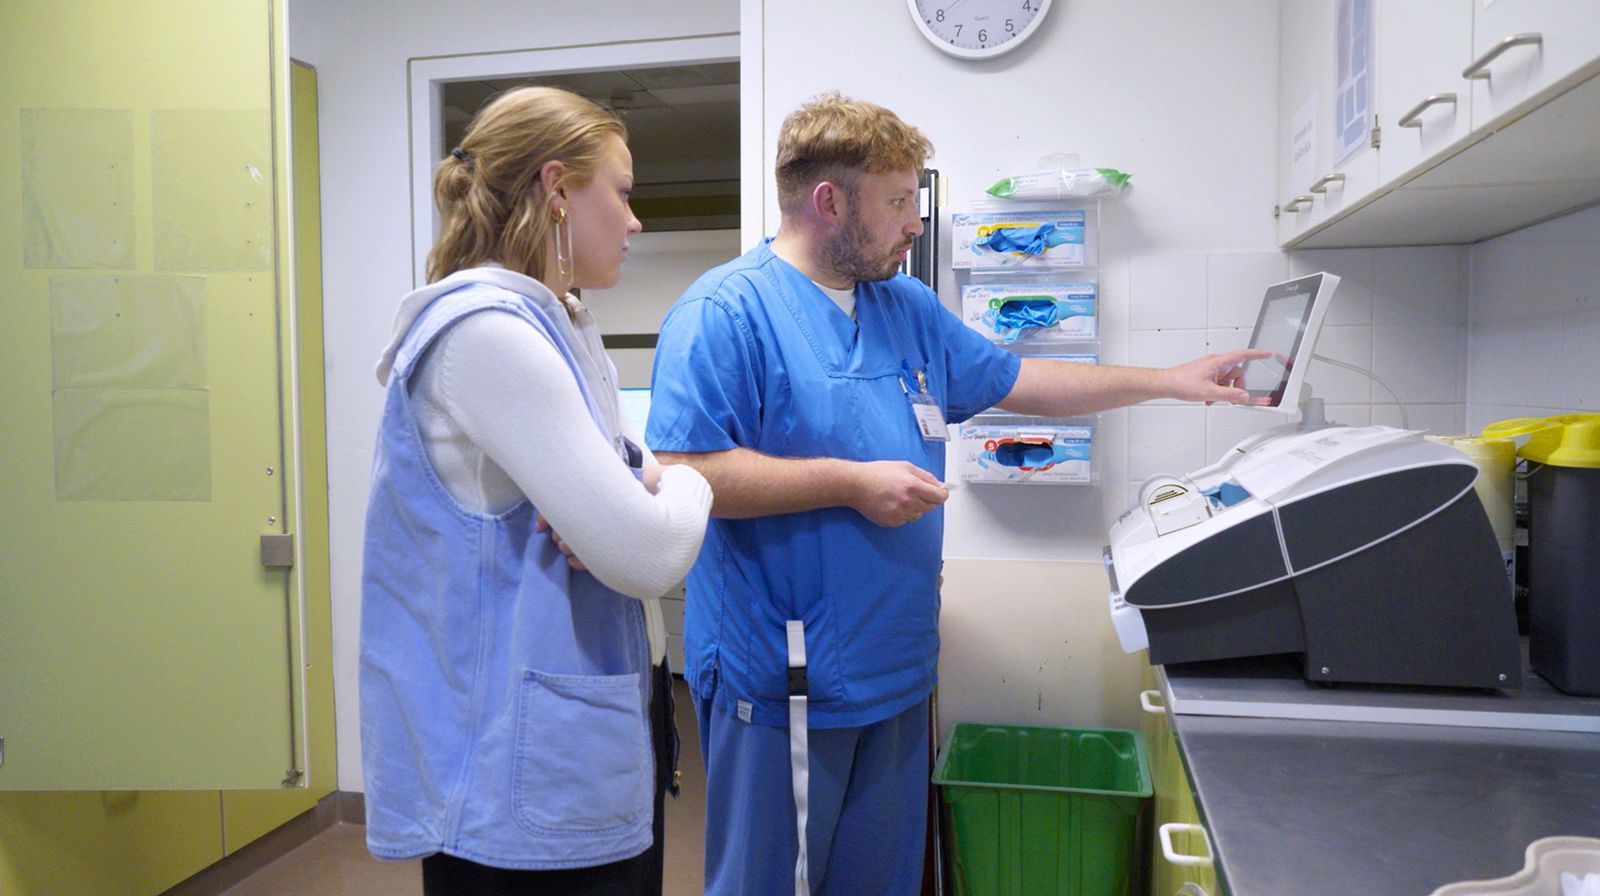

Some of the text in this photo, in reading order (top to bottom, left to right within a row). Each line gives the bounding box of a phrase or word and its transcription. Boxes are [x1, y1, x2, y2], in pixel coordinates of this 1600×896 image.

[1022, 0, 1031, 12] 4
[936, 9, 945, 22] 8
[954, 24, 963, 37] 7
[1005, 19, 1014, 32] 5
[978, 29, 987, 42] 6
[992, 301, 998, 309] L
[988, 442, 995, 451] S
